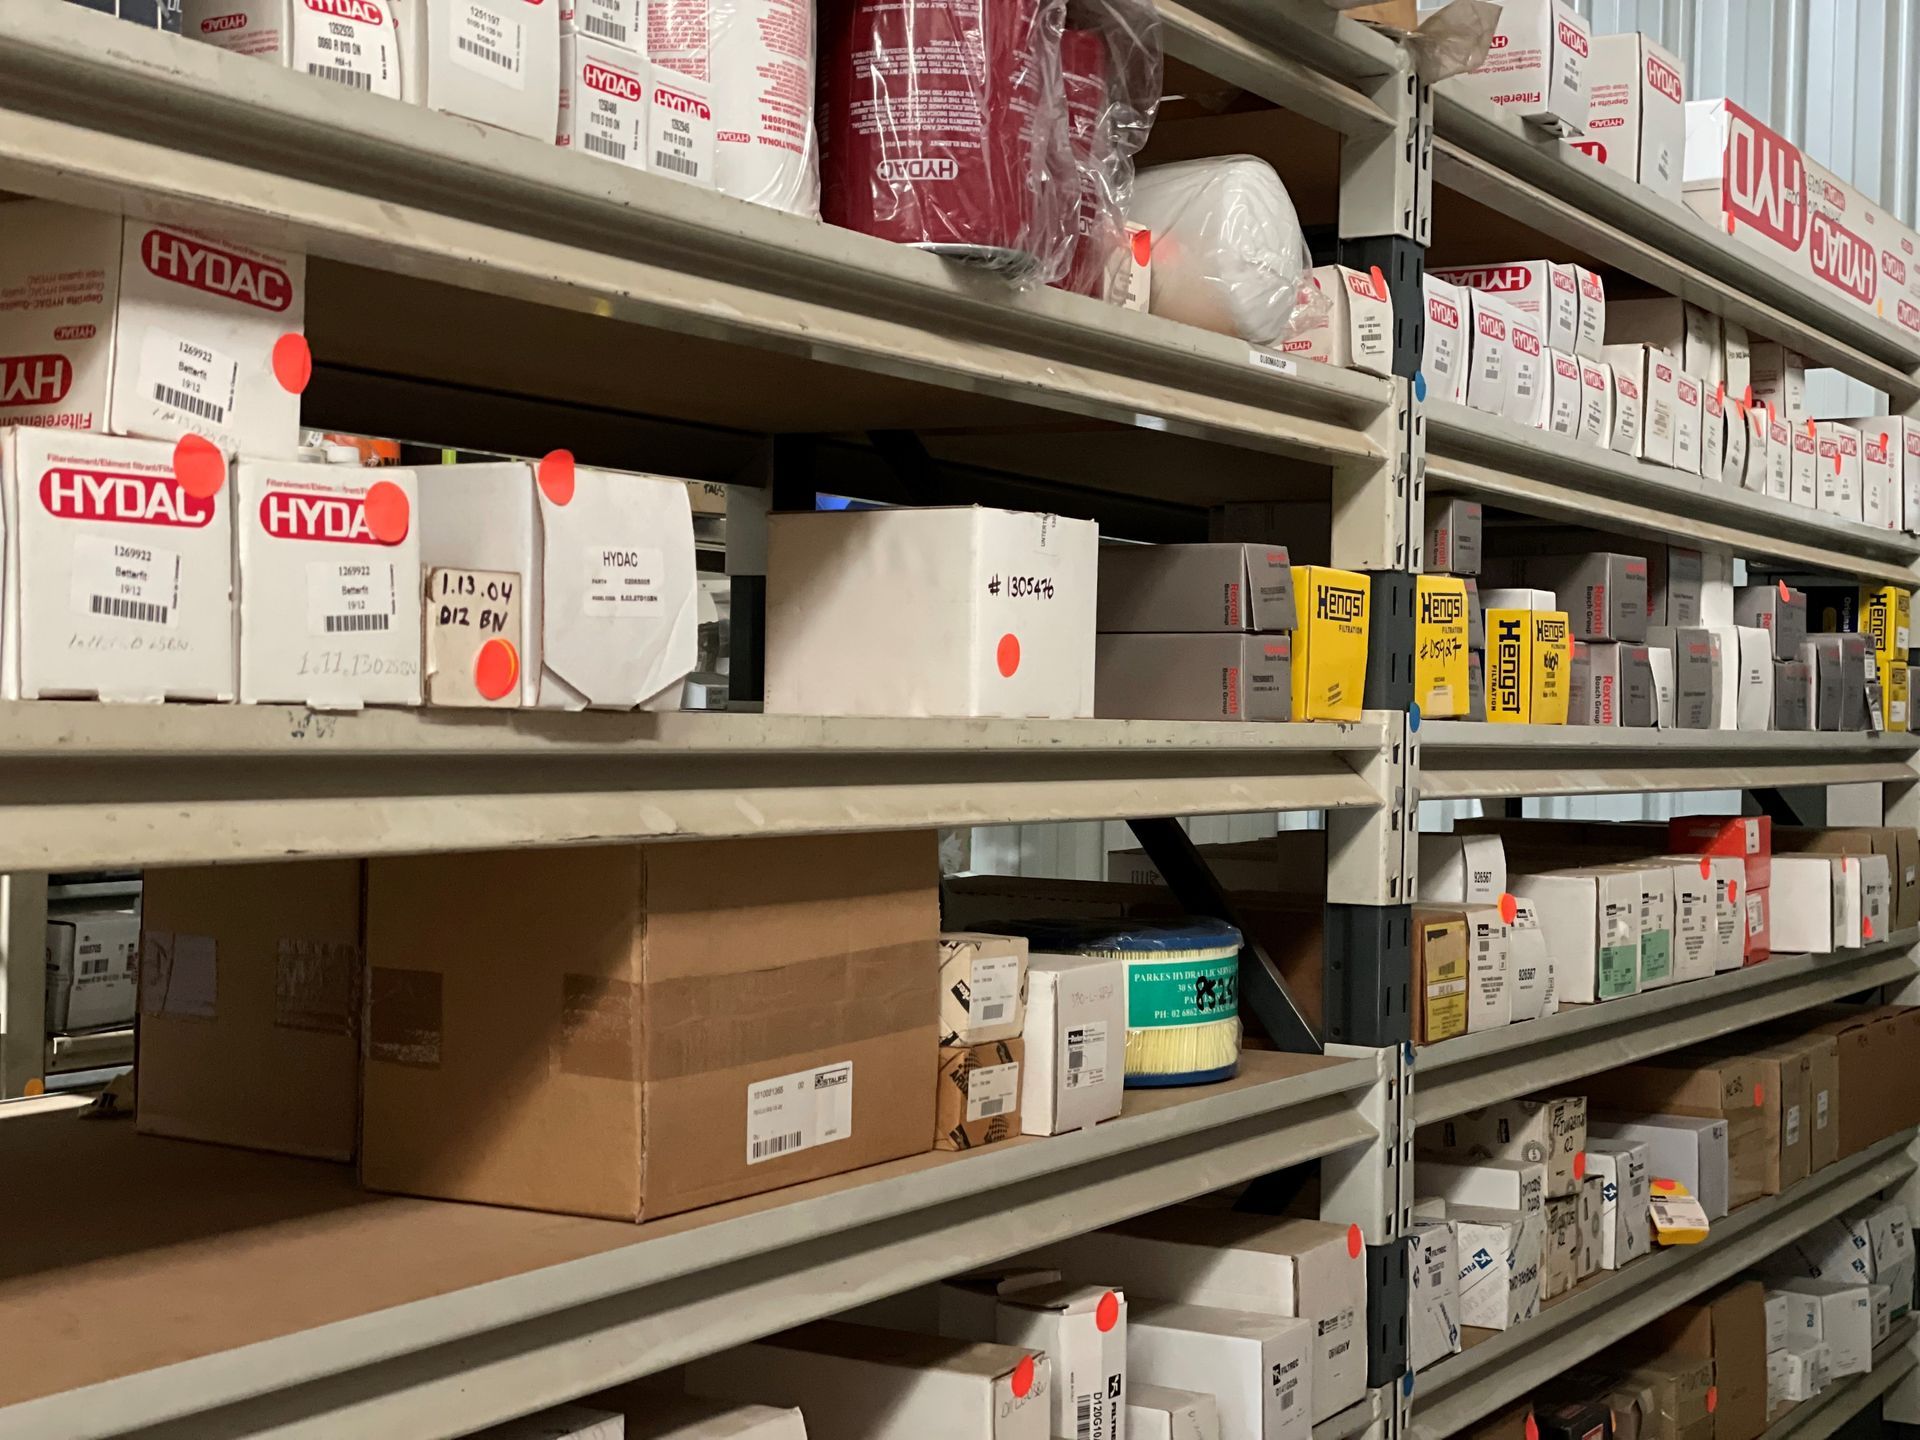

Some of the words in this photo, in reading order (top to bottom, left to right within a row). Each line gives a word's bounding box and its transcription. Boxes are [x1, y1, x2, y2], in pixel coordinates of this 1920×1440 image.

[206, 16, 245, 30] HYDAC
[1561, 24, 1587, 57] HYDAC
[587, 67, 639, 100] HYDAC
[1649, 60, 1681, 103] HYDAC
[657, 90, 710, 121] HYDAC
[1592, 118, 1622, 128] HYDAC
[879, 160, 954, 179] HYDAC
[151, 234, 284, 308] HYDAC
[1814, 220, 1873, 298] HYDAC
[1883, 252, 1905, 284] HYDAC
[1554, 272, 1574, 293] HYDAC
[1430, 300, 1458, 329] HYDAC
[1479, 313, 1505, 340] HYDAC
[178, 341, 213, 363] 1269922
[1513, 329, 1539, 356] HYDAC
[1557, 360, 1577, 380] HYDAC
[1585, 370, 1604, 390] HYDAC
[1619, 378, 1637, 399] HYDAC
[1678, 382, 1696, 405] HYDAC
[51, 472, 206, 523] HYDAC
[270, 496, 376, 540] HYDA
[114, 545, 152, 562] 1269922
[603, 551, 638, 568] HYDAC
[115, 566, 147, 581] Betterfit
[338, 566, 370, 577] 1269922
[442, 573, 513, 602] 1.13.04
[1229, 583, 1239, 626] Rexroth
[1317, 585, 1365, 622] Hengst
[1421, 592, 1463, 624] Hengst
[1595, 586, 1604, 634] Rexroth
[480, 609, 508, 633] BN
[1339, 625, 1362, 635] FILTRATION
[1537, 620, 1566, 642] Hengst
[1498, 620, 1520, 714] Hengst
[1228, 668, 1238, 715] Rexroth
[1603, 676, 1612, 724] Rexroth
[1134, 973, 1171, 983] PARKES
[1171, 1009, 1180, 1018] 02
[1182, 1007, 1197, 1018] 6862
[1281, 1358, 1298, 1375] FILTREC
